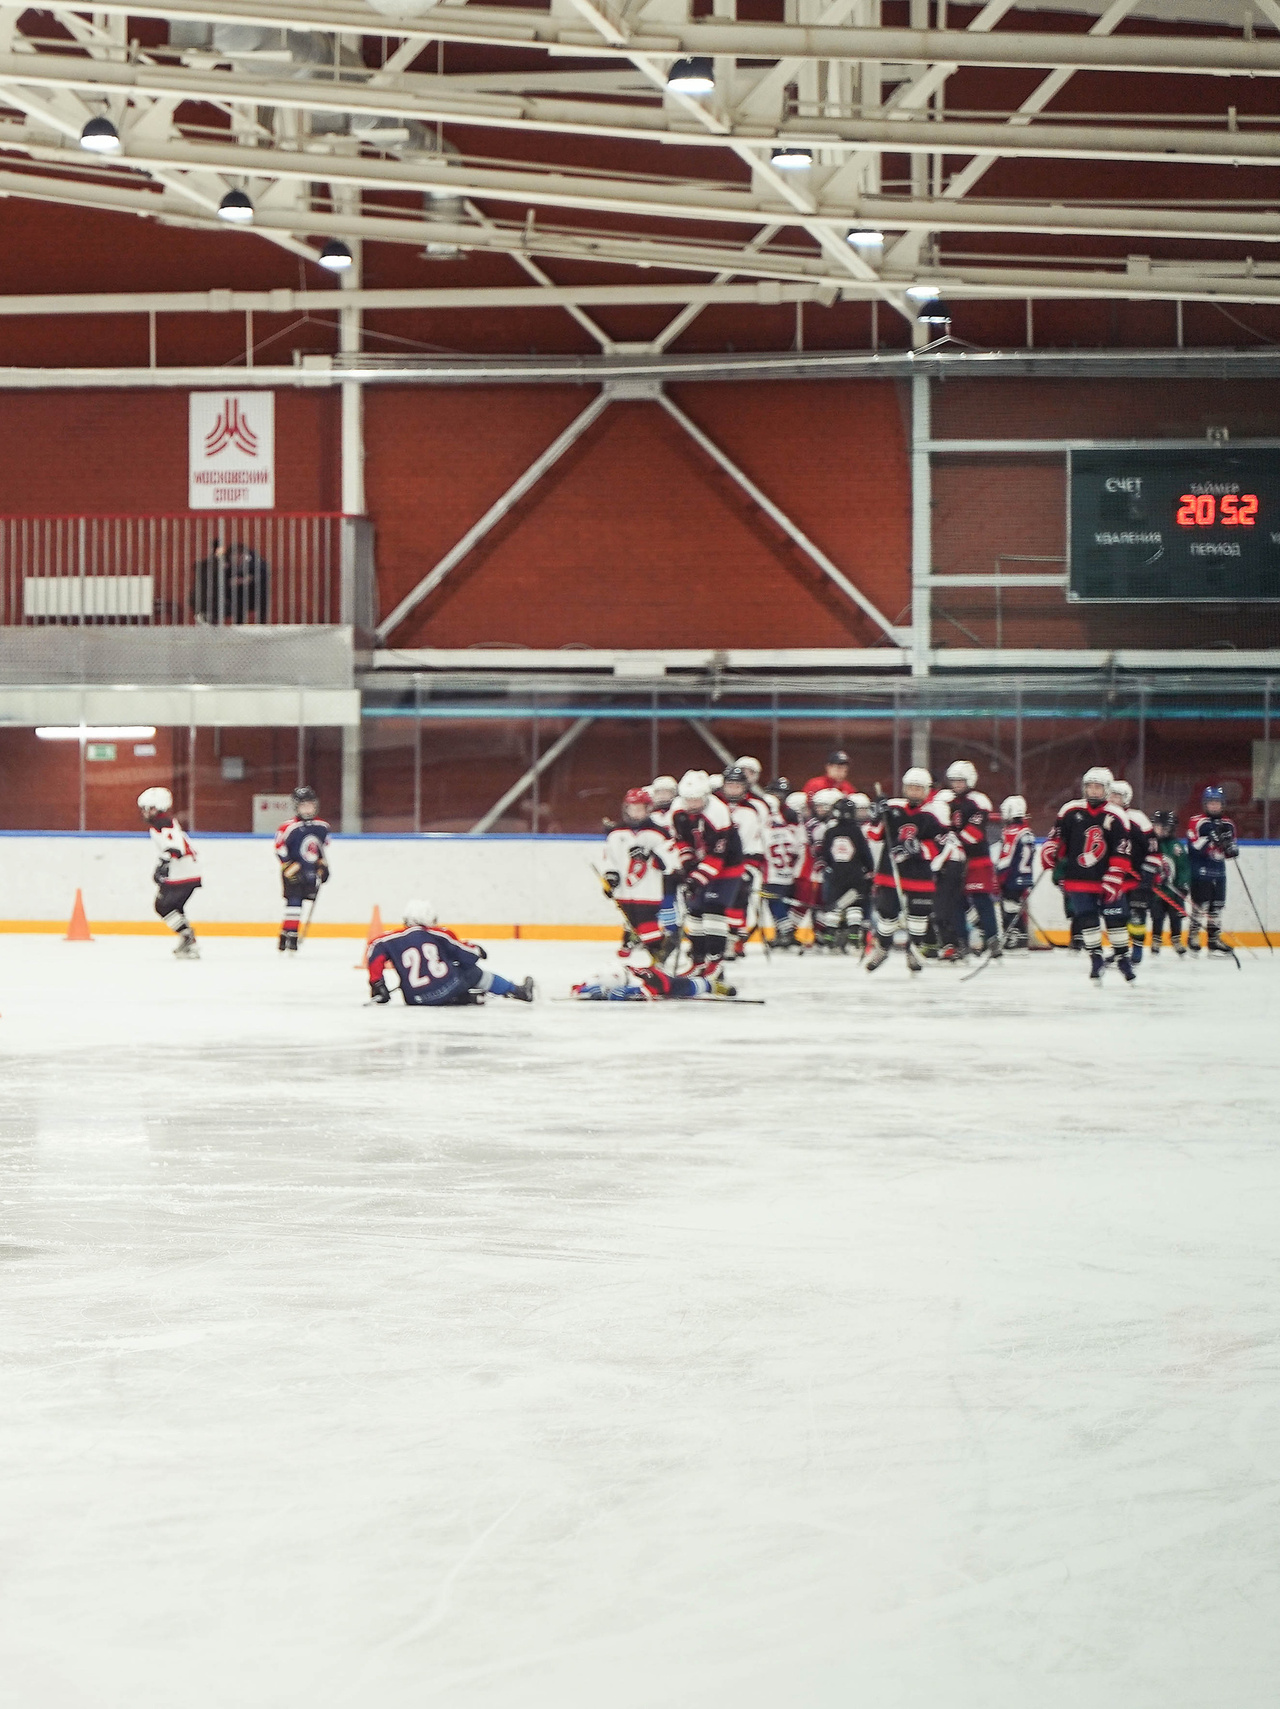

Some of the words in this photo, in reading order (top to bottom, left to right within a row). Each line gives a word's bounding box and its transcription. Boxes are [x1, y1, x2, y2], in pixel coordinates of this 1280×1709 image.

[194, 468, 268, 484] МОСКОВСКИЙ
[1105, 477, 1143, 493] СЧЕТ
[213, 487, 249, 503] СПОРТ
[401, 942, 449, 988] 28
